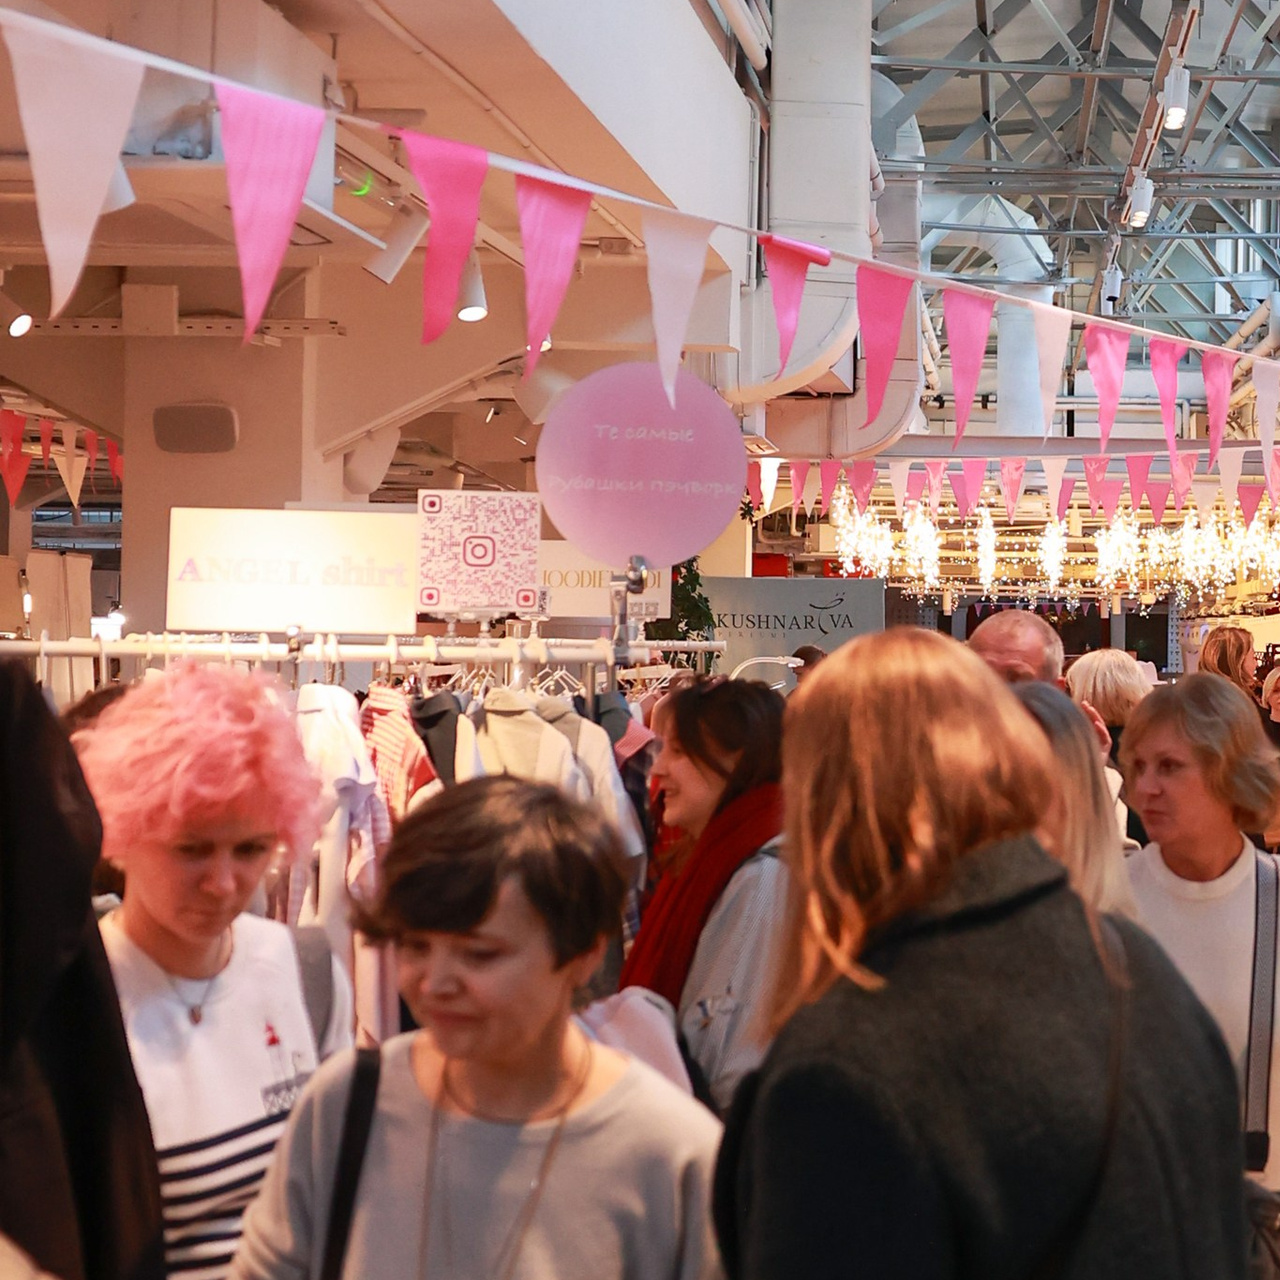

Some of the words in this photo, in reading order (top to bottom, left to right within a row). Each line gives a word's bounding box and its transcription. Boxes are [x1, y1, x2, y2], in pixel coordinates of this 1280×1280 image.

[625, 426, 695, 442] самые
[175, 558, 310, 585] ANGEL
[321, 556, 408, 587] shirt
